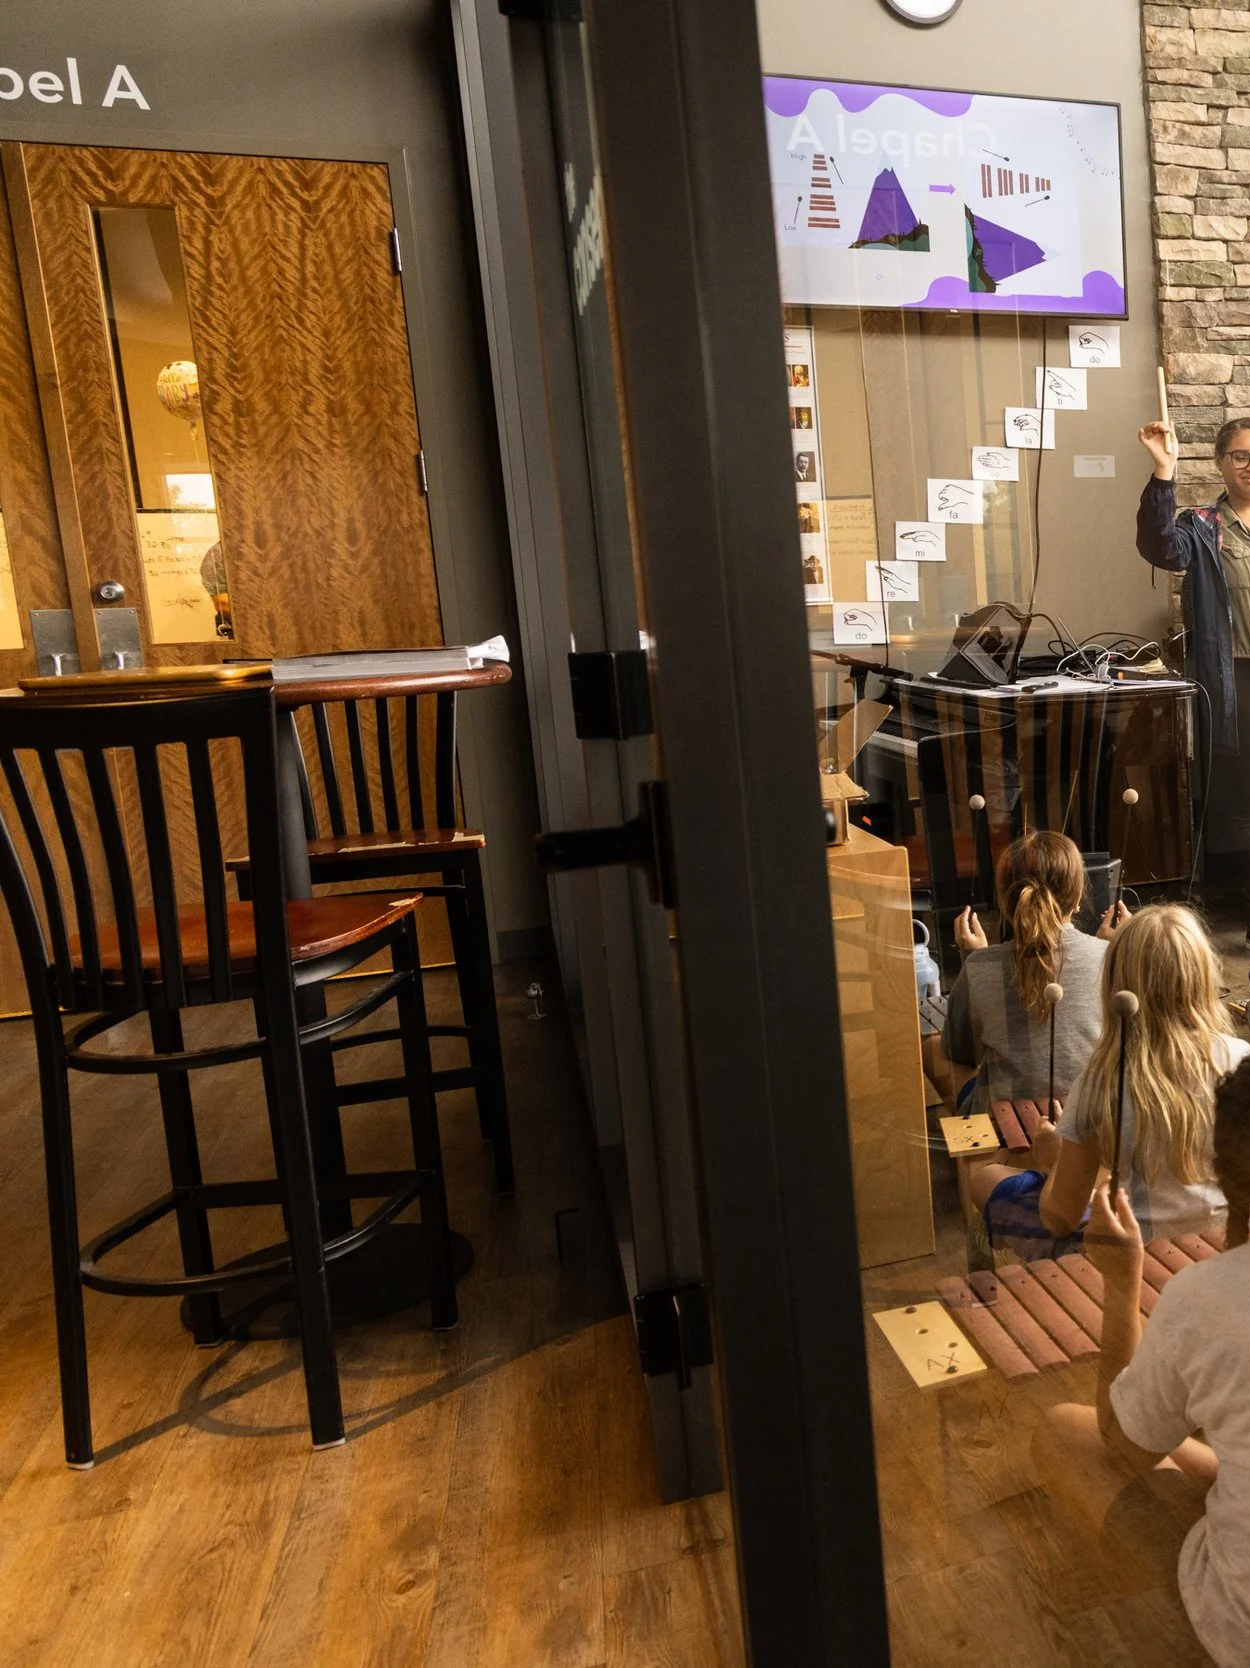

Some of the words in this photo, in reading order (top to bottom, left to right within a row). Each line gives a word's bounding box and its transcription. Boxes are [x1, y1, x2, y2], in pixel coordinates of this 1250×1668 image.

[102, 64, 151, 110] A
[790, 153, 808, 161] High
[1089, 355, 1101, 364] do
[1057, 397, 1063, 405] ti
[1025, 436, 1032, 444] la
[949, 510, 959, 519] fa
[915, 548, 925, 557] mi
[855, 632, 868, 640] do
[952, 1135, 974, 1144] SX
[927, 1351, 960, 1372] AX
